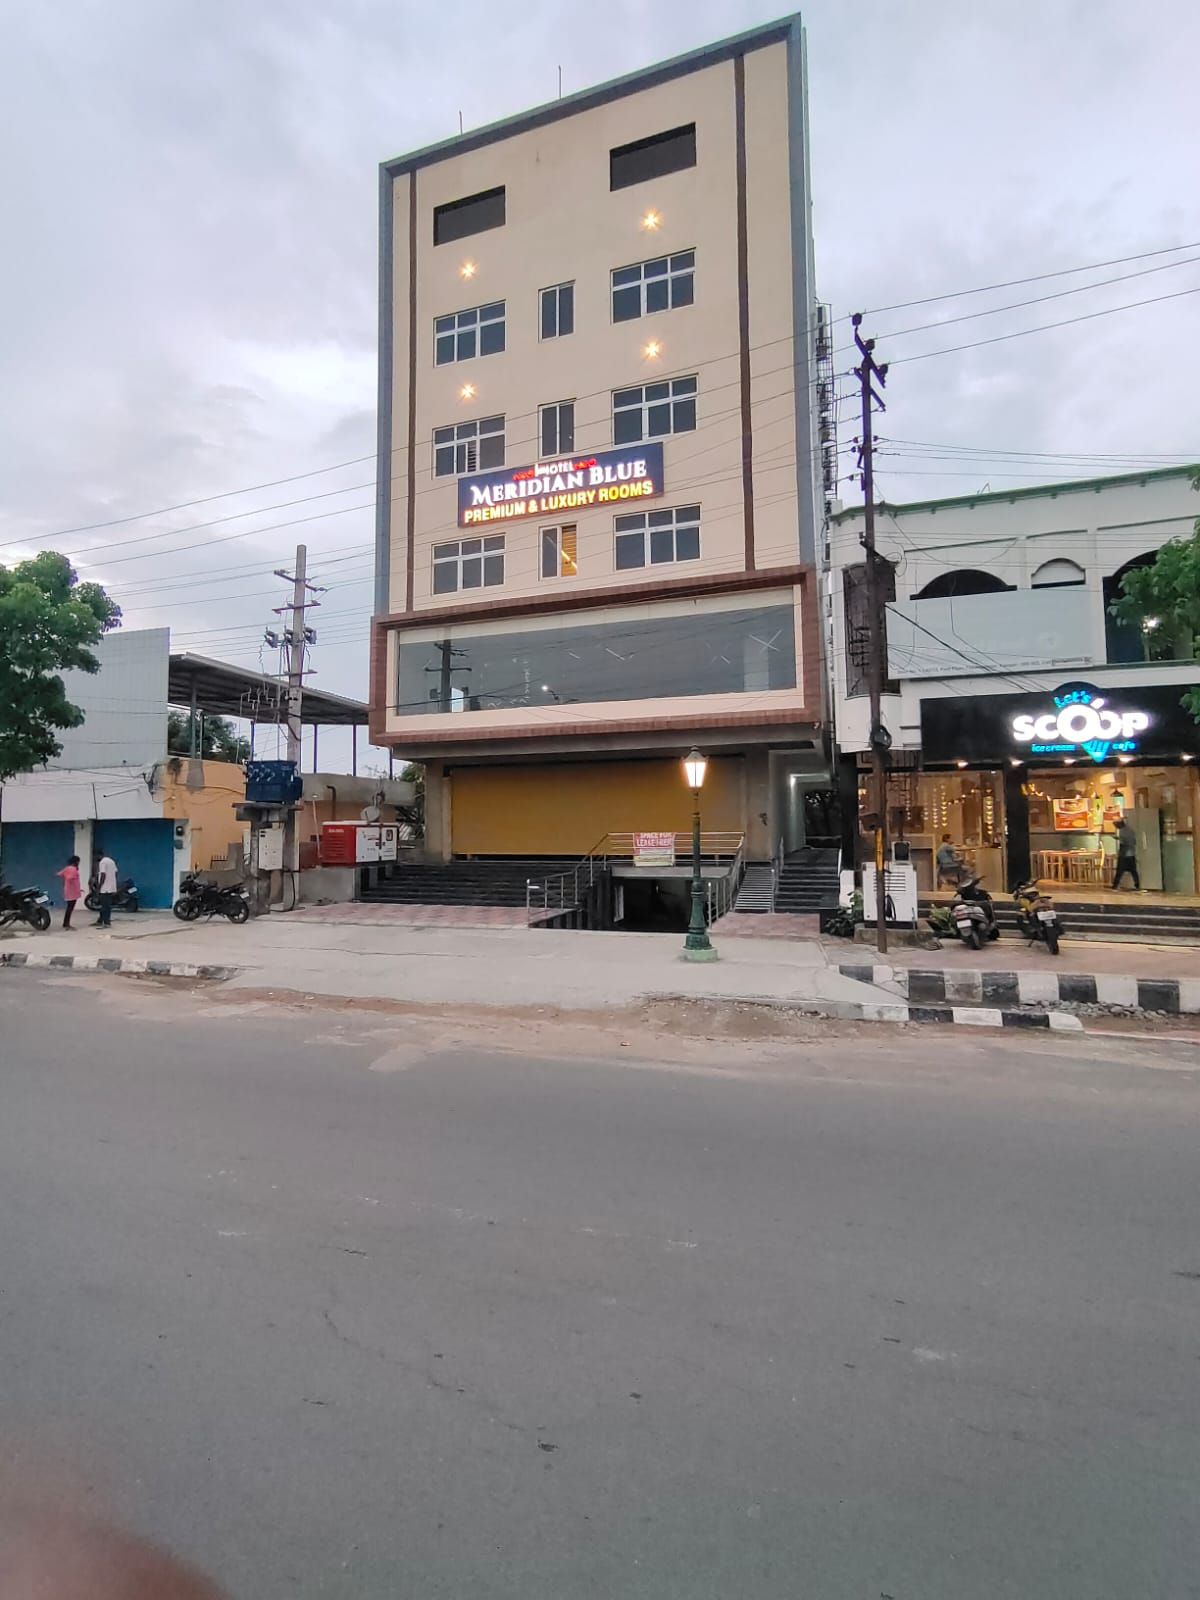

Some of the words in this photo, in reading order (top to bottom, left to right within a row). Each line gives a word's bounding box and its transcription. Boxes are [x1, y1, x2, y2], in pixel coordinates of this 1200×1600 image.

[470, 473, 584, 506] MERIDIAN
[589, 460, 647, 486] BLUE
[543, 461, 575, 476] HOTEL
[464, 502, 526, 524] PREMIUM
[528, 502, 538, 514] &
[541, 491, 596, 511] LUXURY
[598, 480, 654, 502] ROOMS
[1053, 690, 1092, 709] Let's
